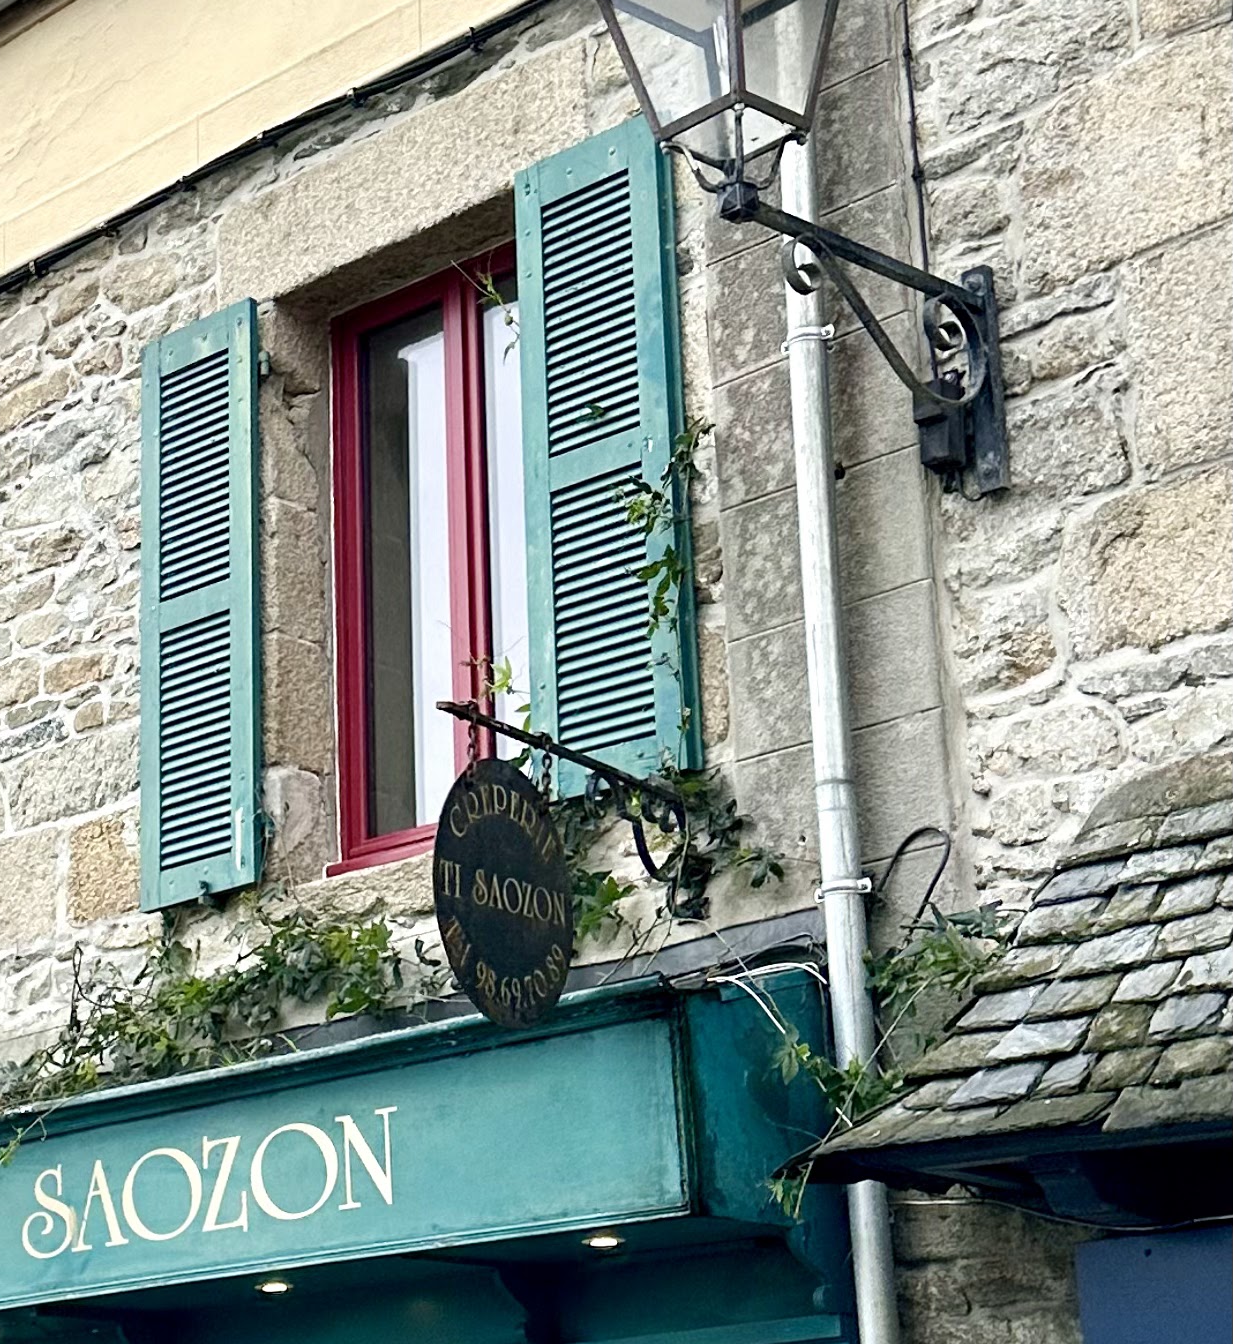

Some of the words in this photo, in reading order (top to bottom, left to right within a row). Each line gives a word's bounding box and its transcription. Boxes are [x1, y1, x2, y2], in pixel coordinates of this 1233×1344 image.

[450, 784, 556, 864] CREPERIE
[439, 859, 461, 898] TI
[473, 869, 566, 927] SAOZON
[21, 1106, 399, 1259] SAOZON
